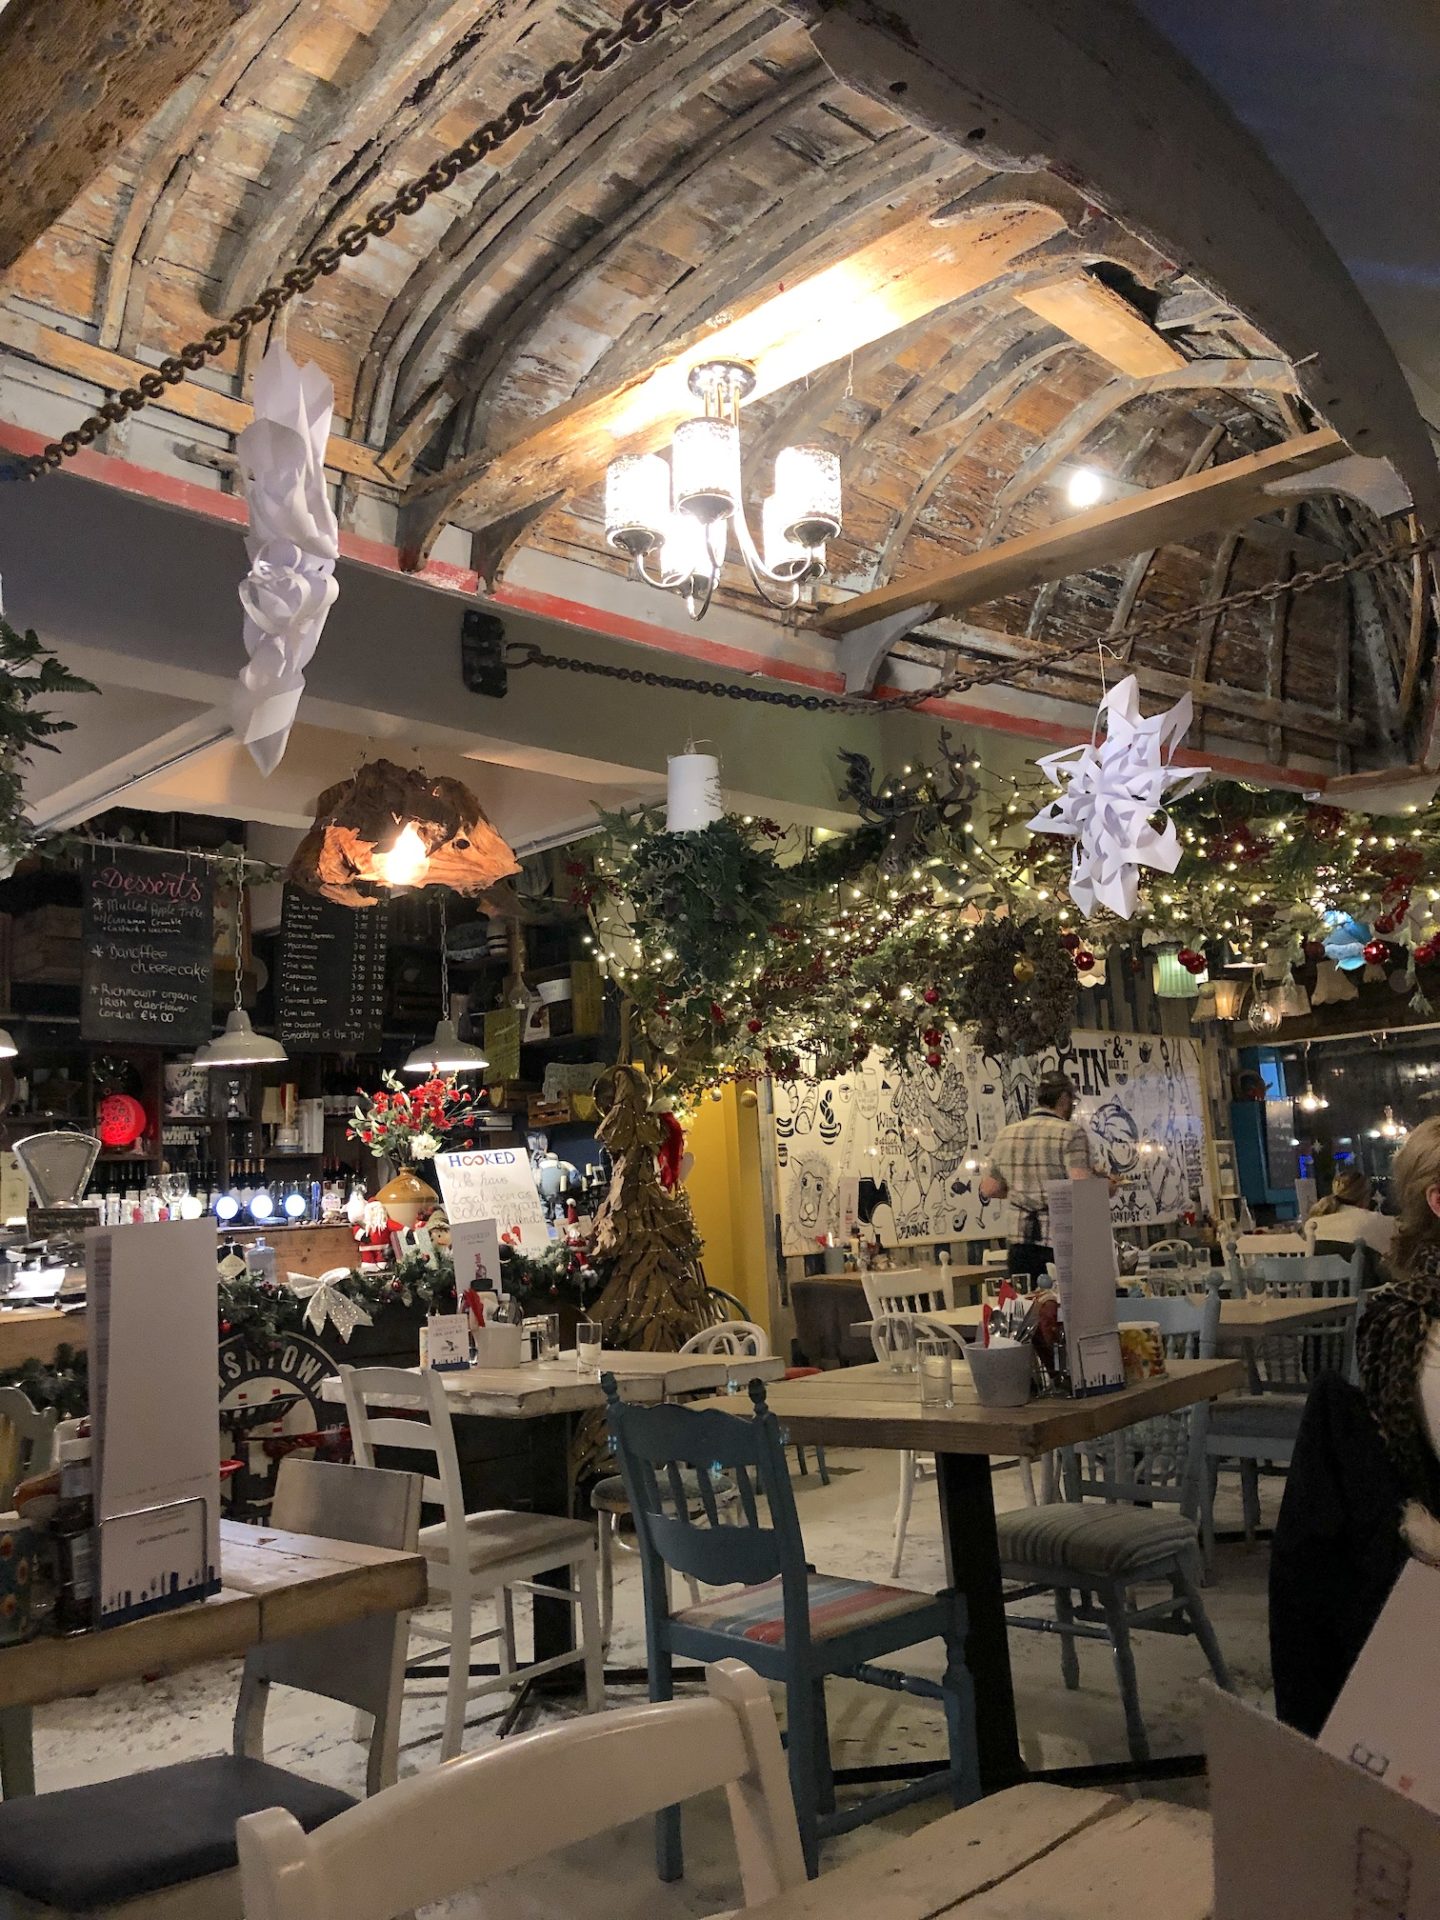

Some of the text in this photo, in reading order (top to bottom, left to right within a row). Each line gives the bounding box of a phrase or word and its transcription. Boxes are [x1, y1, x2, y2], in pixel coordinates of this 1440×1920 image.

[92, 867, 201, 903] Desserts
[107, 899, 147, 913] Mulled
[110, 943, 168, 960] Banoffee
[161, 990, 199, 1005] organic
[1058, 1048, 1110, 1096] GIN
[448, 1151, 516, 1167] HOOKED
